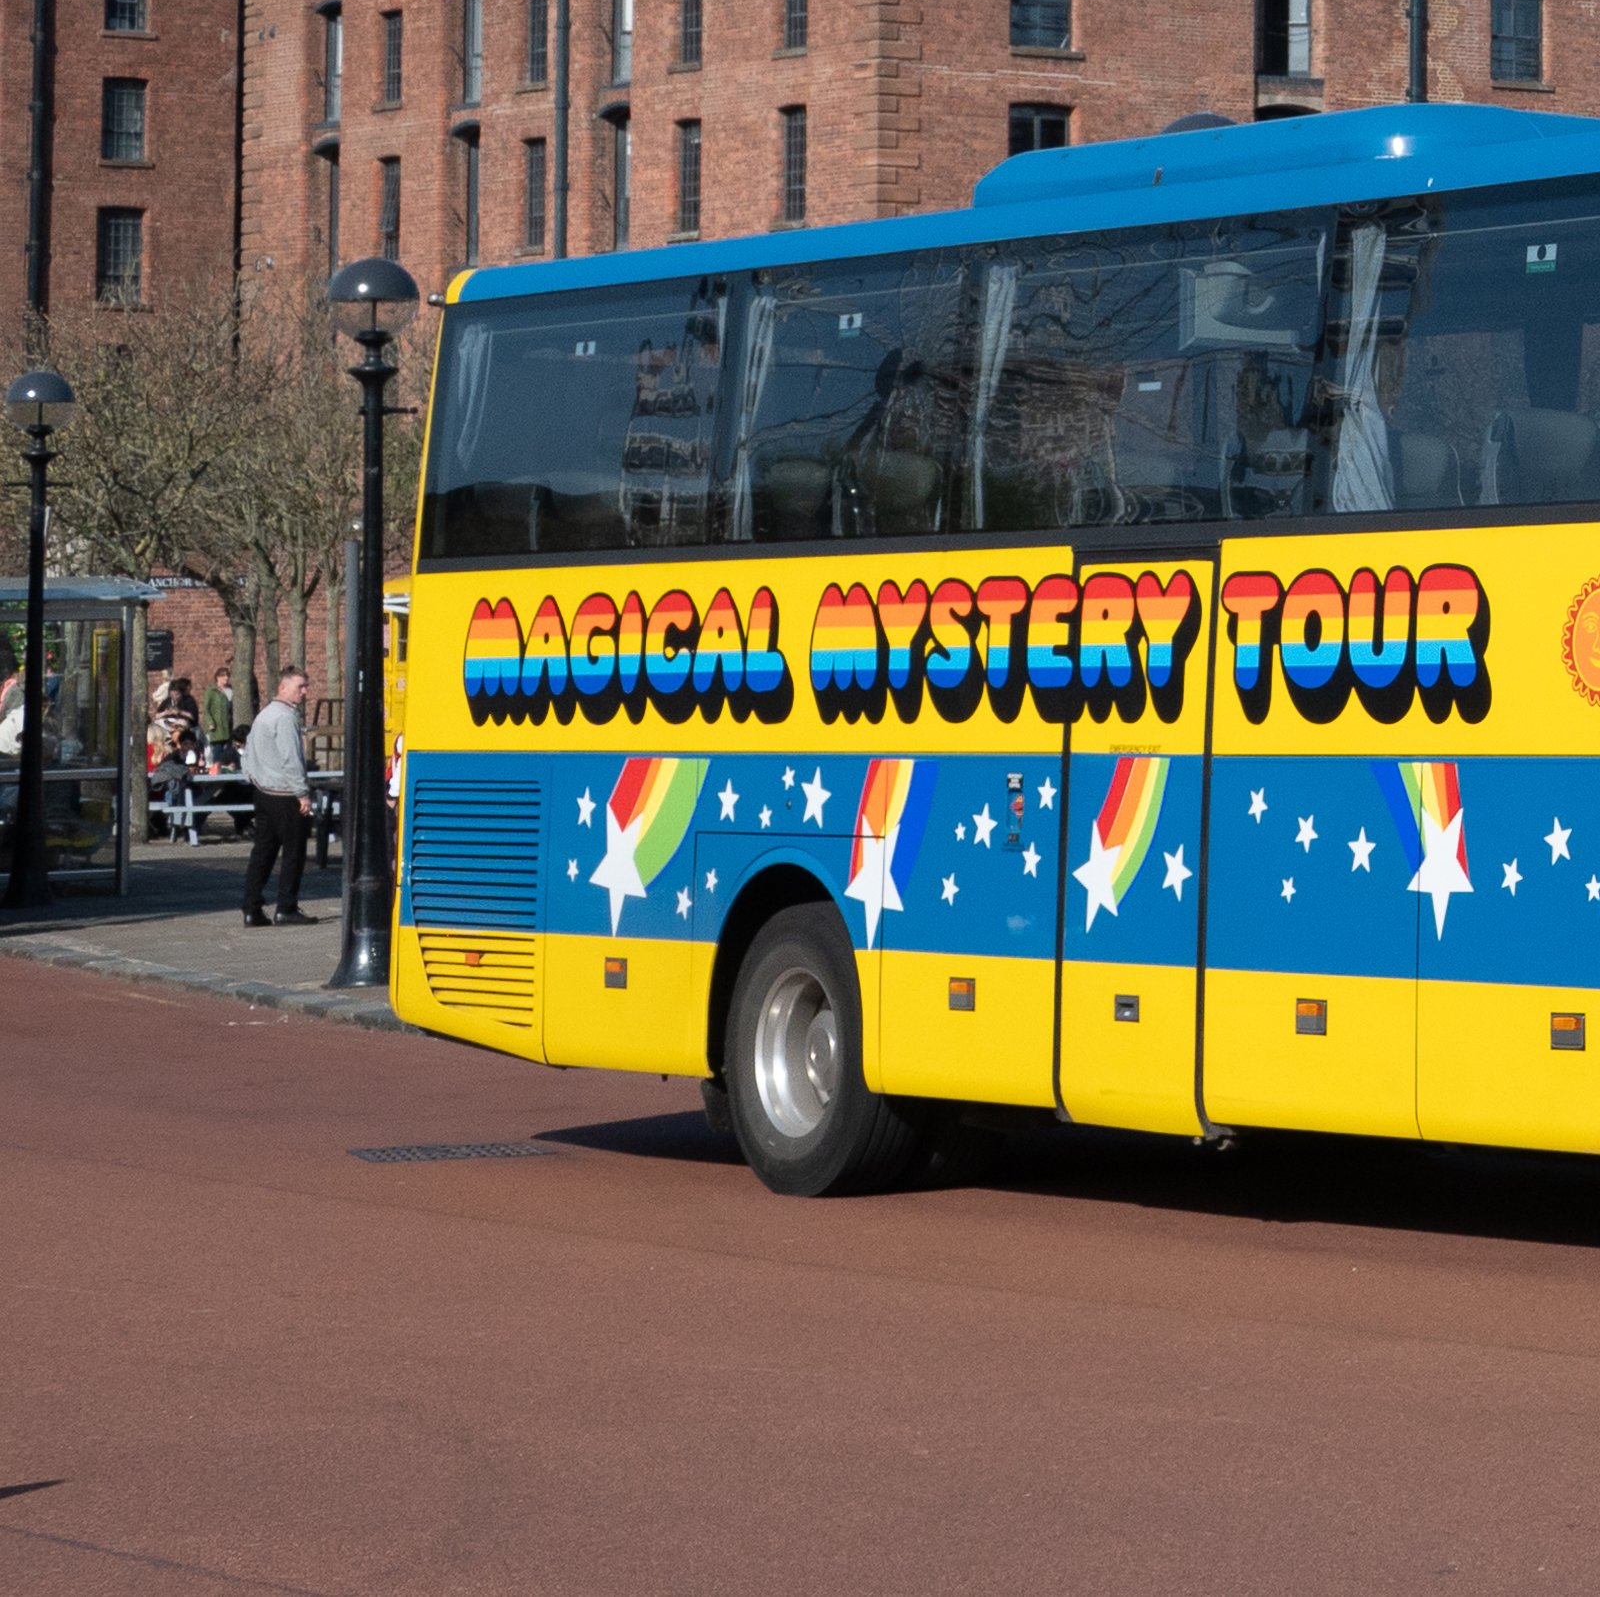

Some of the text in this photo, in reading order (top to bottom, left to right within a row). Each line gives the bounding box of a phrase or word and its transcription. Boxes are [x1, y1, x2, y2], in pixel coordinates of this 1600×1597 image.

[149, 577, 192, 588] ANCHOR
[464, 563, 1492, 727] MAGICAL MYSTERY TOUR
